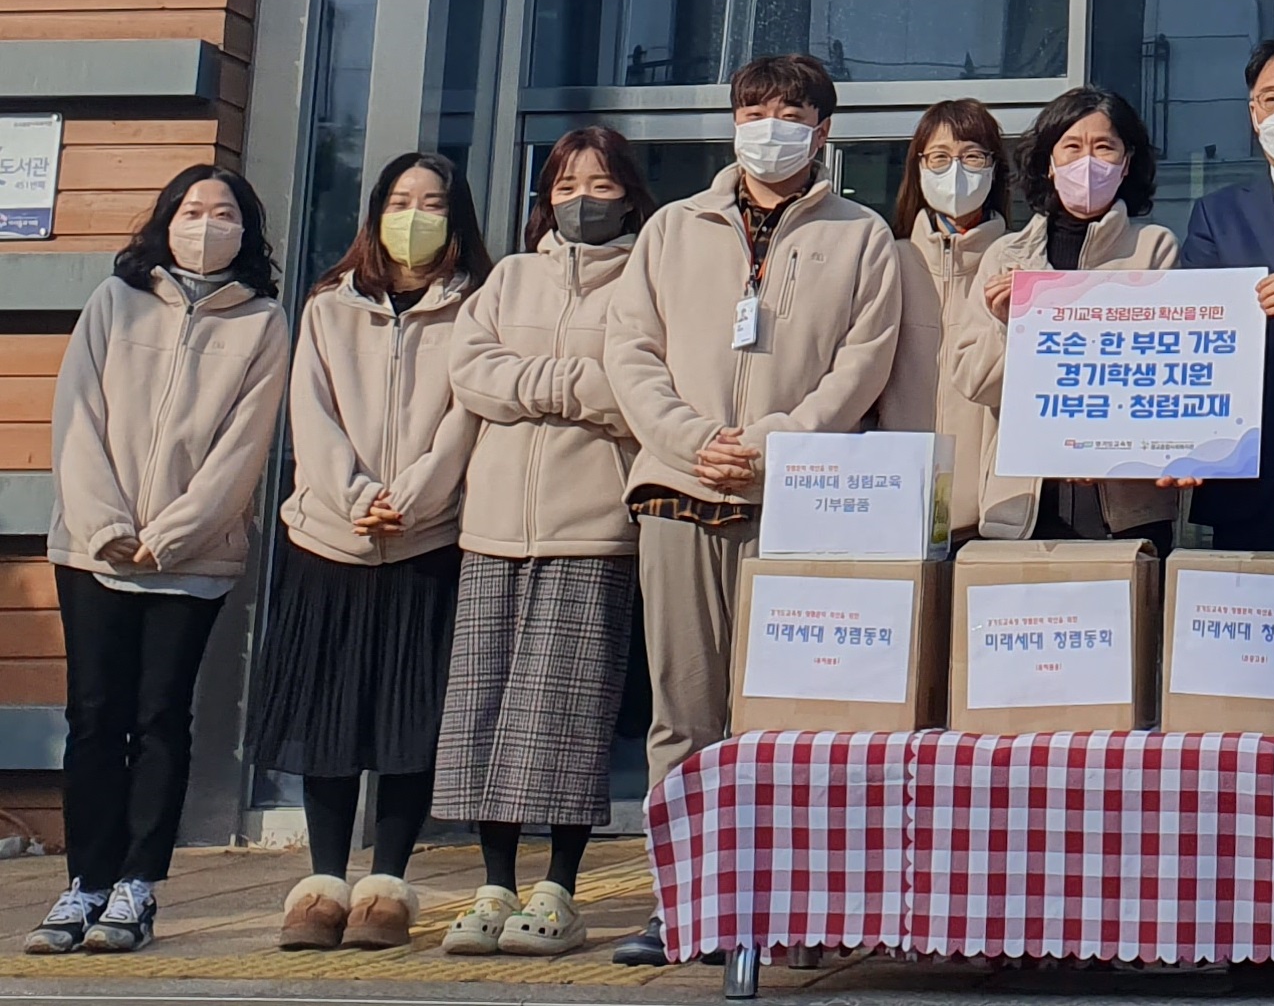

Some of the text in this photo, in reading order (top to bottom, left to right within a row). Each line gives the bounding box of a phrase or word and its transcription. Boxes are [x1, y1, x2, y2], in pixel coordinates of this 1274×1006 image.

[1052, 306, 1224, 322] 경기교육 청렴문화 확산을 위한
[1131, 330, 1180, 355] 부모
[1187, 329, 1237, 355] 가정
[1056, 361, 1213, 387] 경기학생 지원
[785, 474, 902, 490] 미래세대 청렴교육
[815, 497, 870, 512] 기부물품
[766, 623, 892, 646] 미래세대 청렴동화
[985, 629, 1112, 651] 미래세대 청렴동화
[1192, 619, 1252, 641] 미래세대
